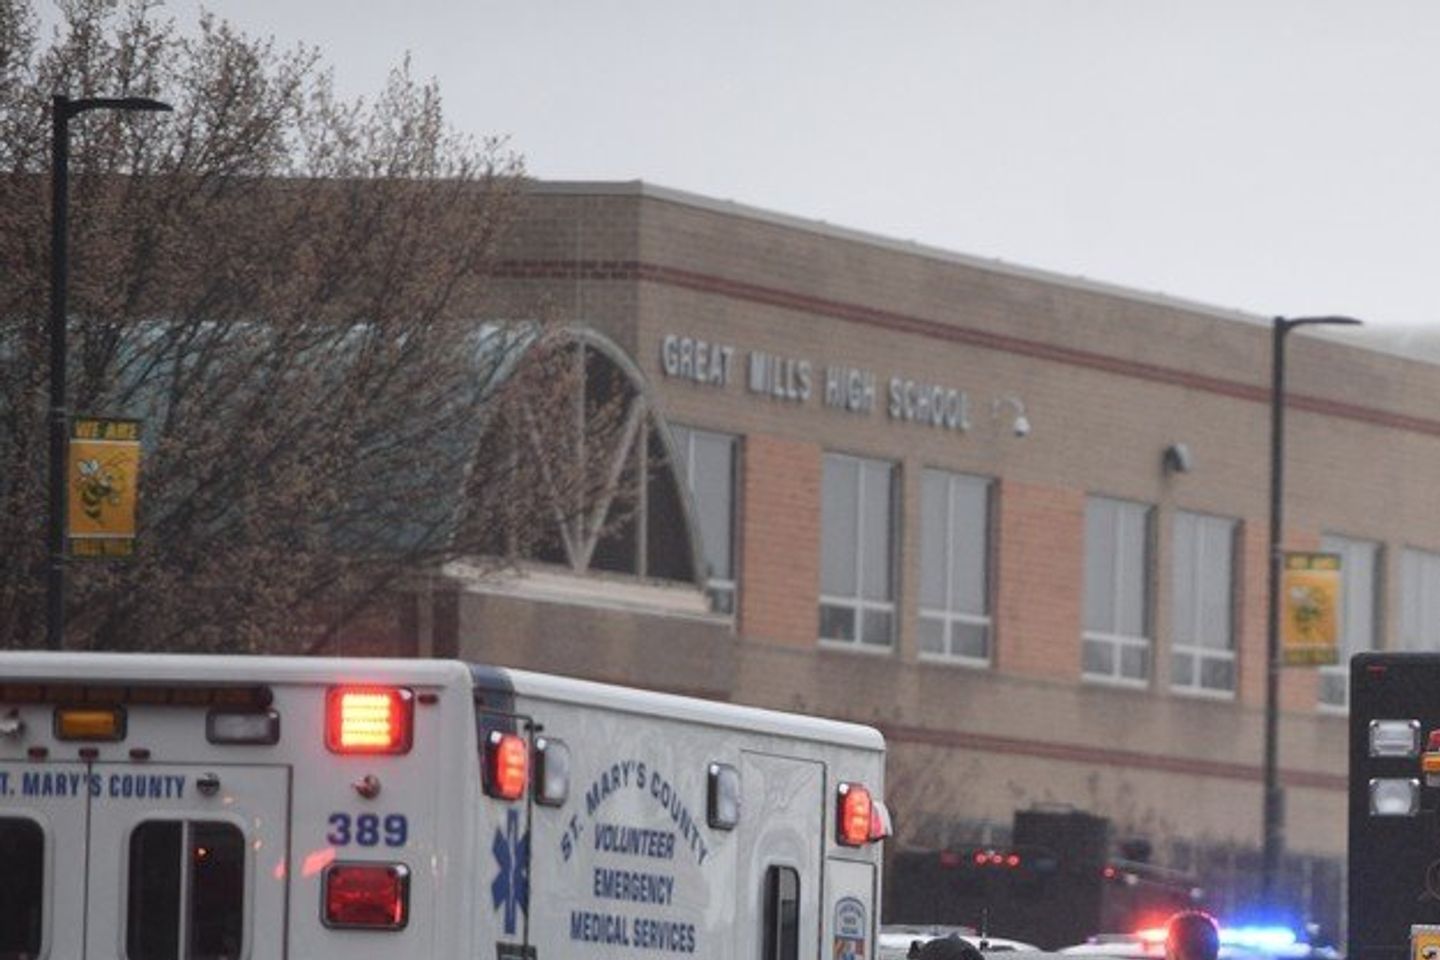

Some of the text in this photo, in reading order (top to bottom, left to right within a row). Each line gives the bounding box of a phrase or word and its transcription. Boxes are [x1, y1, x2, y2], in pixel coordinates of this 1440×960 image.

[662, 334, 971, 433] GREAT MILLS HIGH SCHOOL
[22, 772, 102, 797] MARY'S
[110, 775, 186, 799] COUNTY
[327, 813, 408, 847] 389
[586, 759, 647, 816] MARY'S
[650, 770, 708, 866] COUNTY
[594, 823, 676, 860] VOLUNTEER
[594, 867, 674, 905] EMERGENCY
[570, 911, 695, 954] MEDICAL SERVICES
